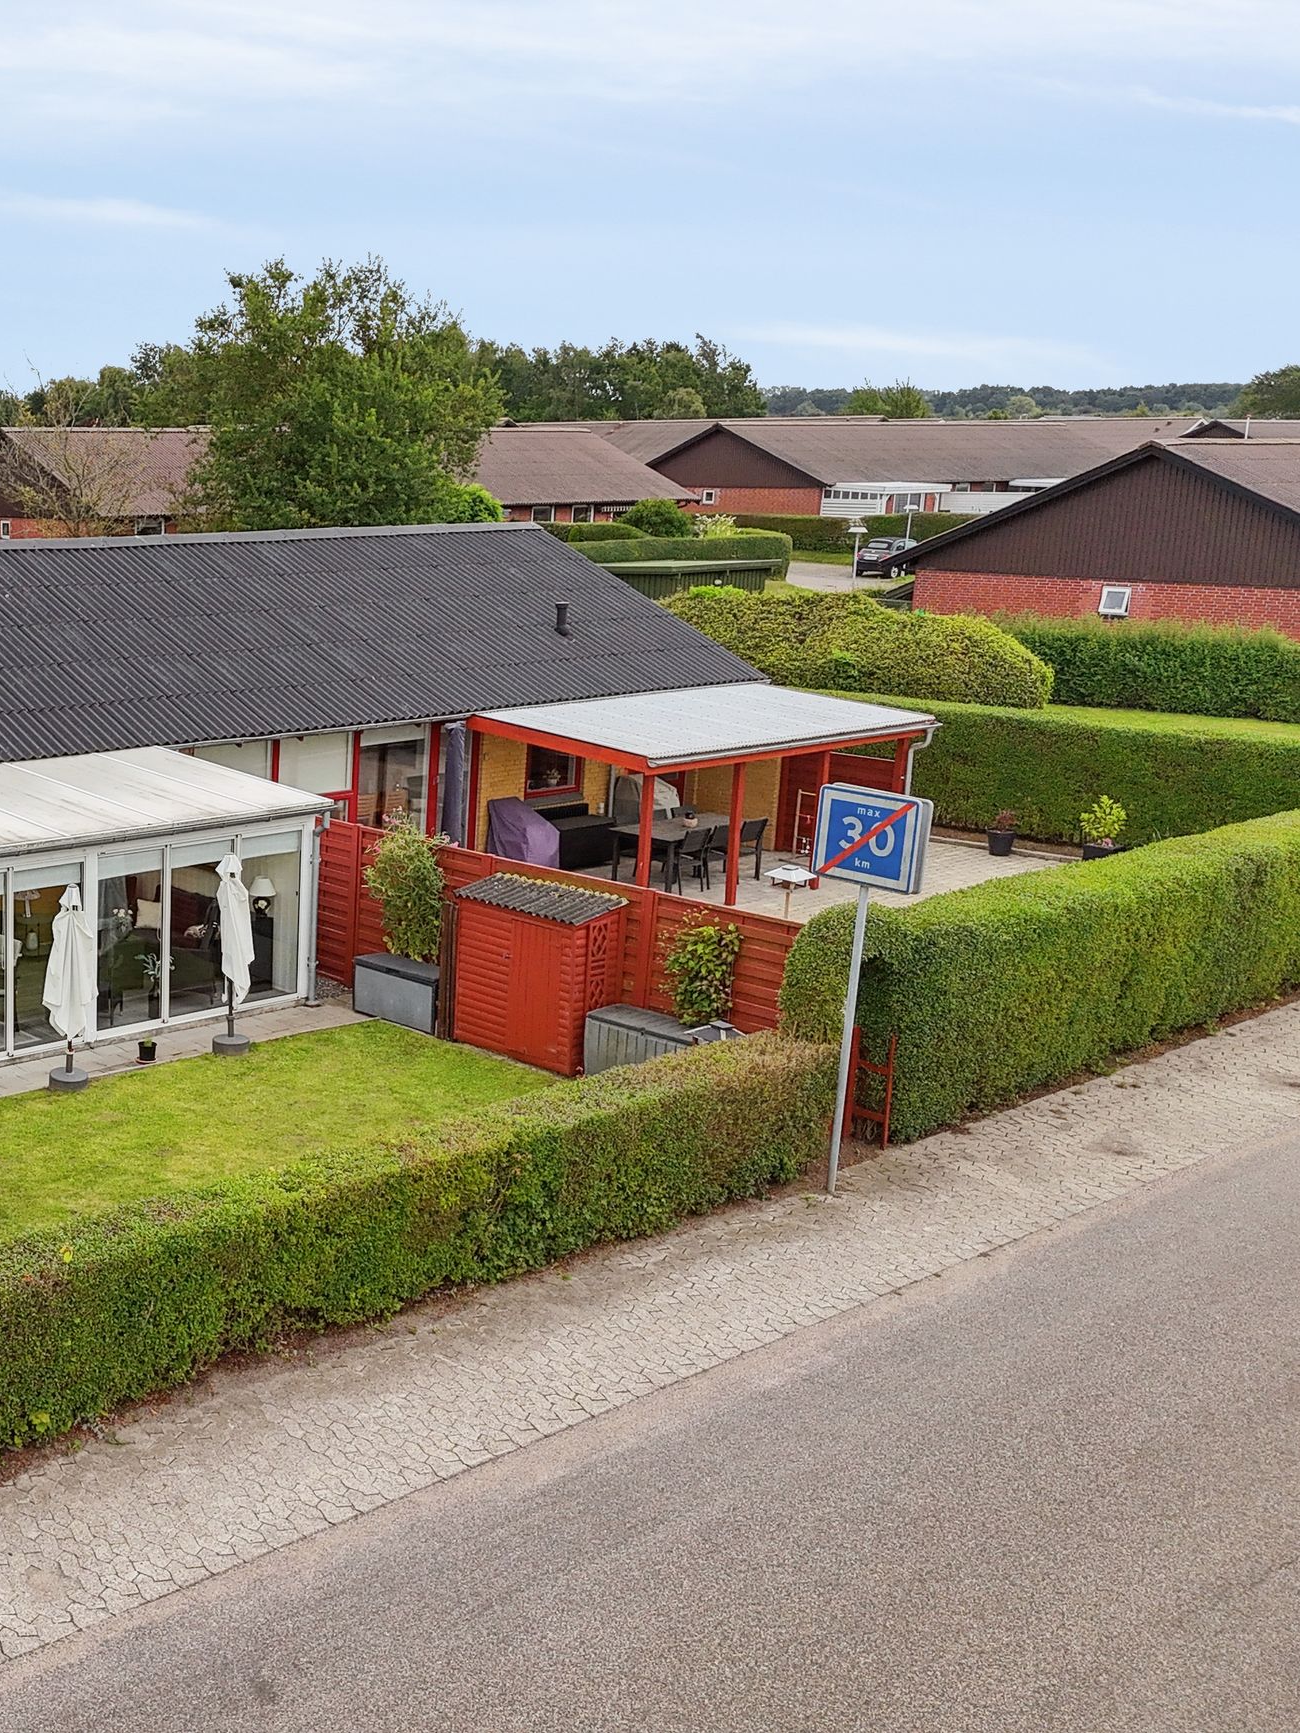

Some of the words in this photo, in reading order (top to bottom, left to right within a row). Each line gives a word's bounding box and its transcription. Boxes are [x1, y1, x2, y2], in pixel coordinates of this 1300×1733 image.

[857, 807, 880, 818] max
[838, 816, 895, 857] 30
[854, 857, 870, 869] km
